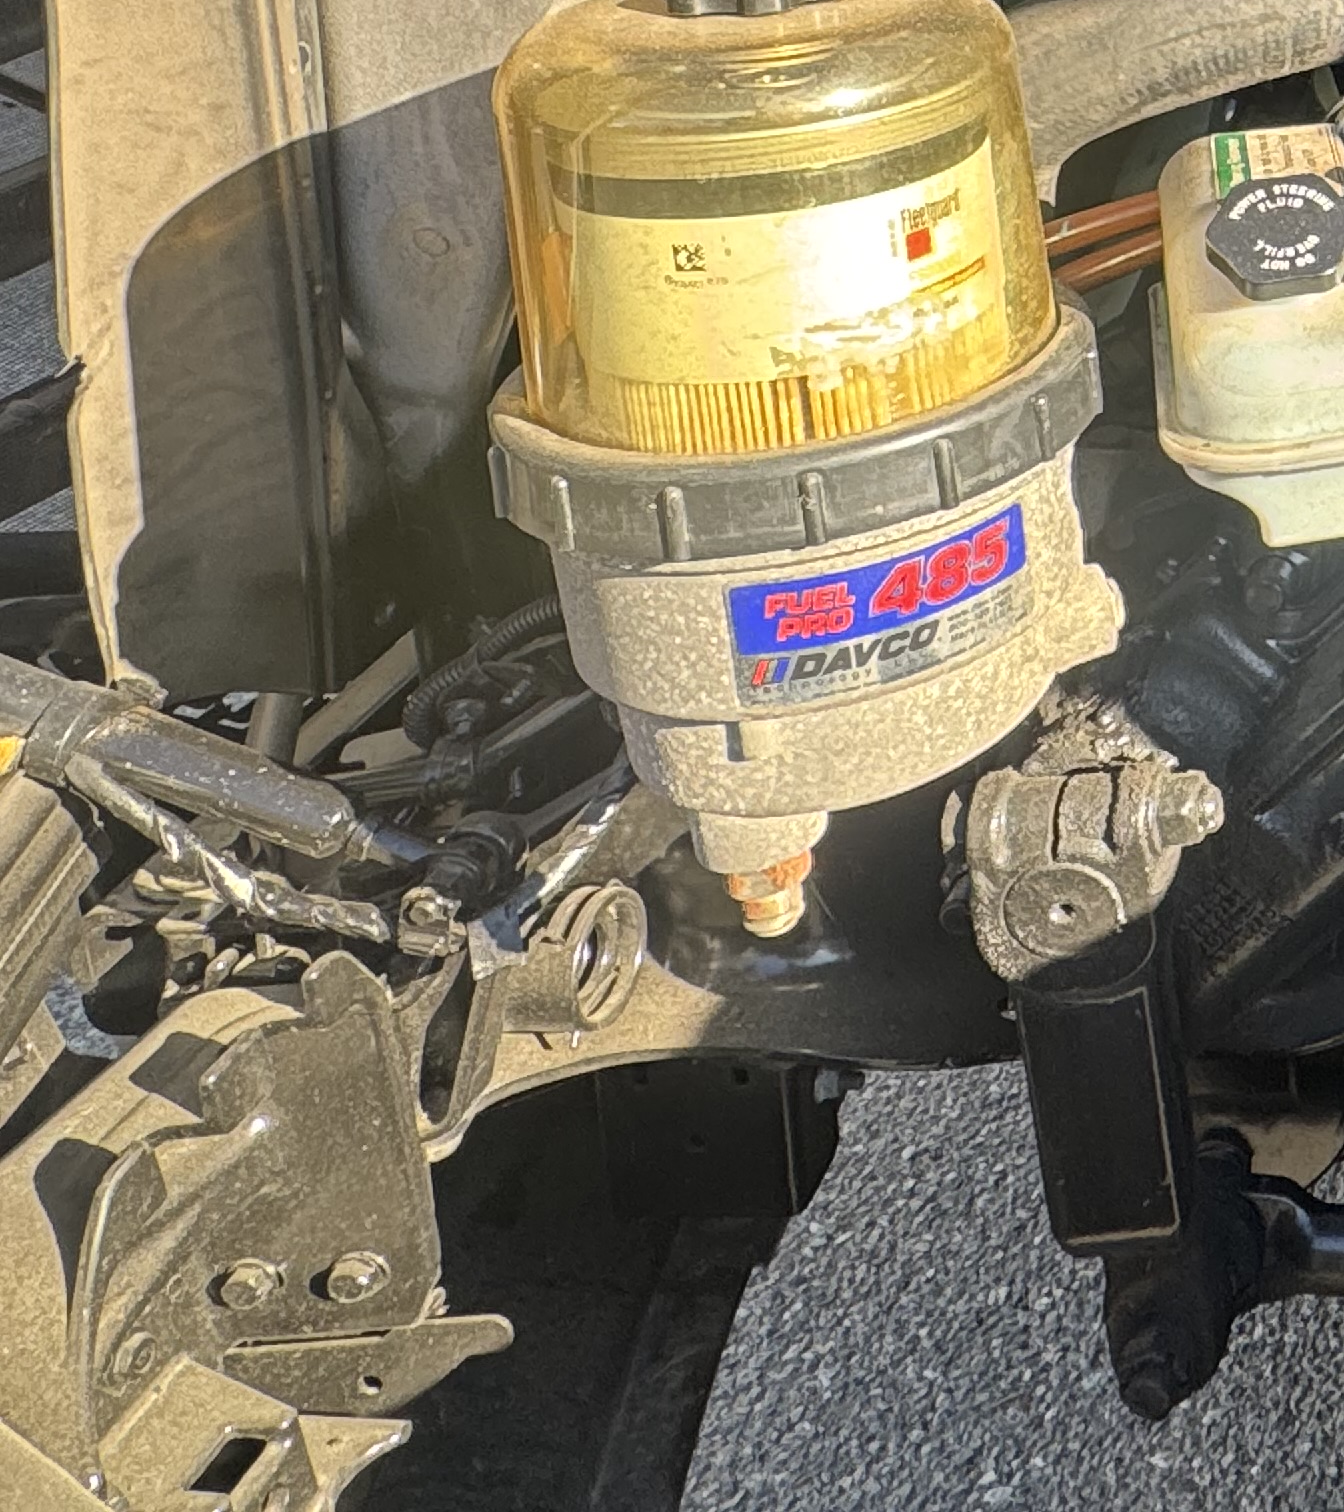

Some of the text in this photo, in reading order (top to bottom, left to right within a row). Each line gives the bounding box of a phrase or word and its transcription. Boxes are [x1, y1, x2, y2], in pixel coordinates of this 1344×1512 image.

[1228, 183, 1335, 221] POWER STEERING
[1257, 196, 1304, 214] FLUID
[1253, 234, 1321, 259] OVERFILL
[1260, 258, 1290, 271] NOT
[764, 581, 855, 619] FUEL
[868, 516, 1010, 618] 485
[776, 605, 854, 642] PRO
[789, 619, 940, 681] DAVCO
